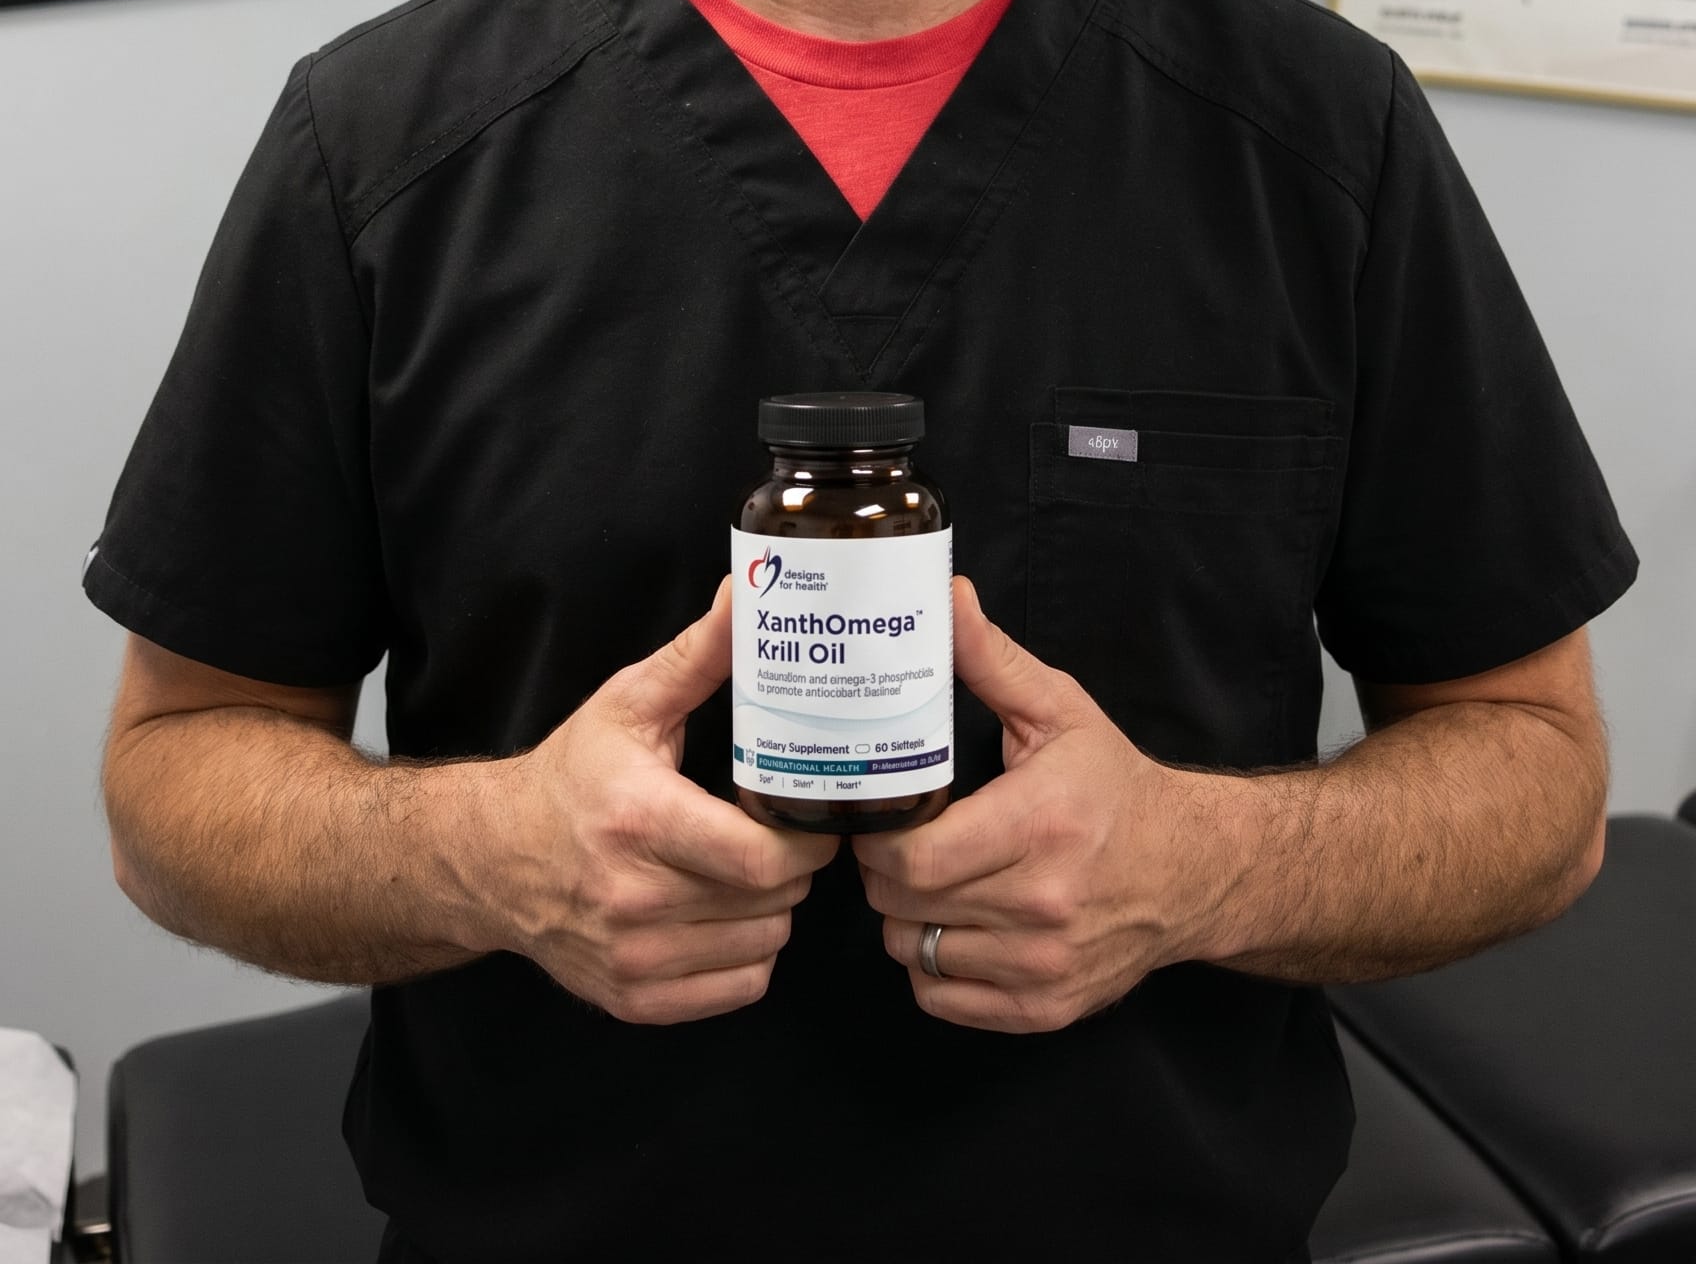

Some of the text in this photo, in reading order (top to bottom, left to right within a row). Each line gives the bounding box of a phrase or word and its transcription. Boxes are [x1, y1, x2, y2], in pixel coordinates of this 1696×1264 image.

[784, 569, 825, 582] designs
[779, 580, 792, 589] for
[757, 638, 845, 664] Krill Oil
[809, 674, 827, 685] and
[766, 684, 803, 696] promote
[789, 742, 849, 755] Supplement
[875, 743, 888, 753] 60
